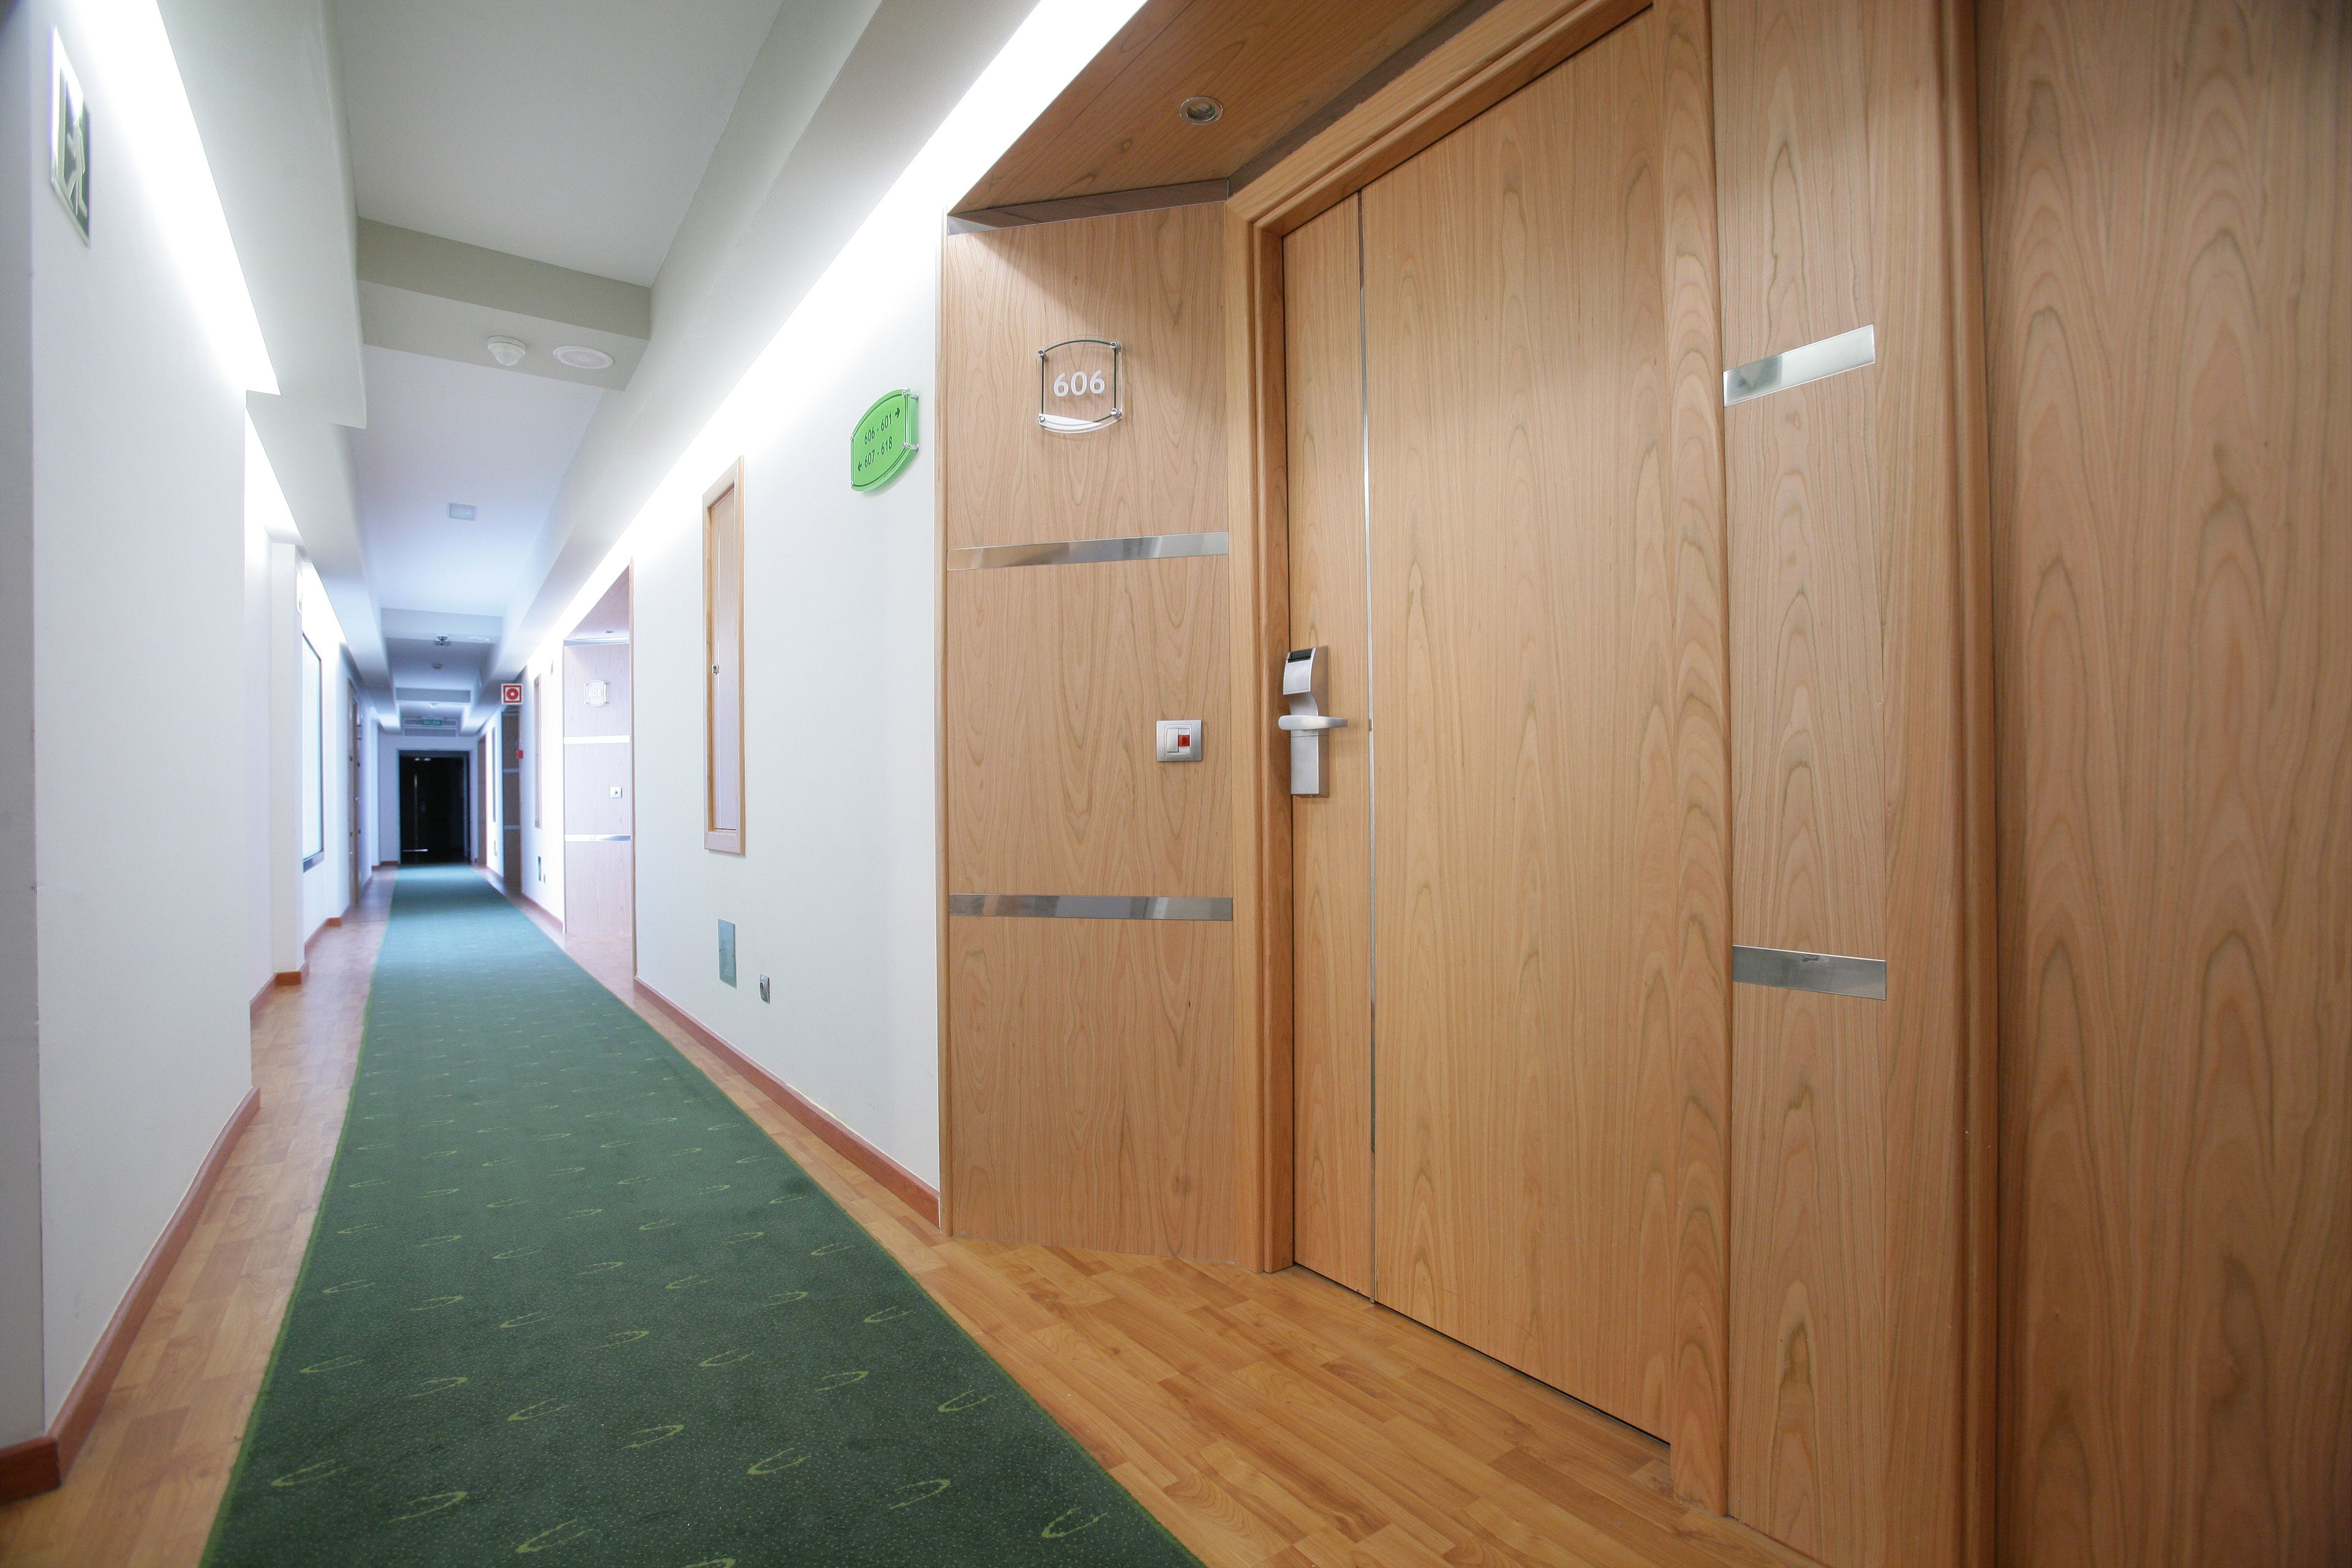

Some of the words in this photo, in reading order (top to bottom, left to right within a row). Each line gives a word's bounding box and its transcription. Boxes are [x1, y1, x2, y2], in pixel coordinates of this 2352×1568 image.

[1054, 369, 1106, 398] 606
[864, 426, 875, 445] 606
[881, 412, 892, 431] 601
[864, 450, 875, 468] 607
[881, 436, 893, 455] 618
